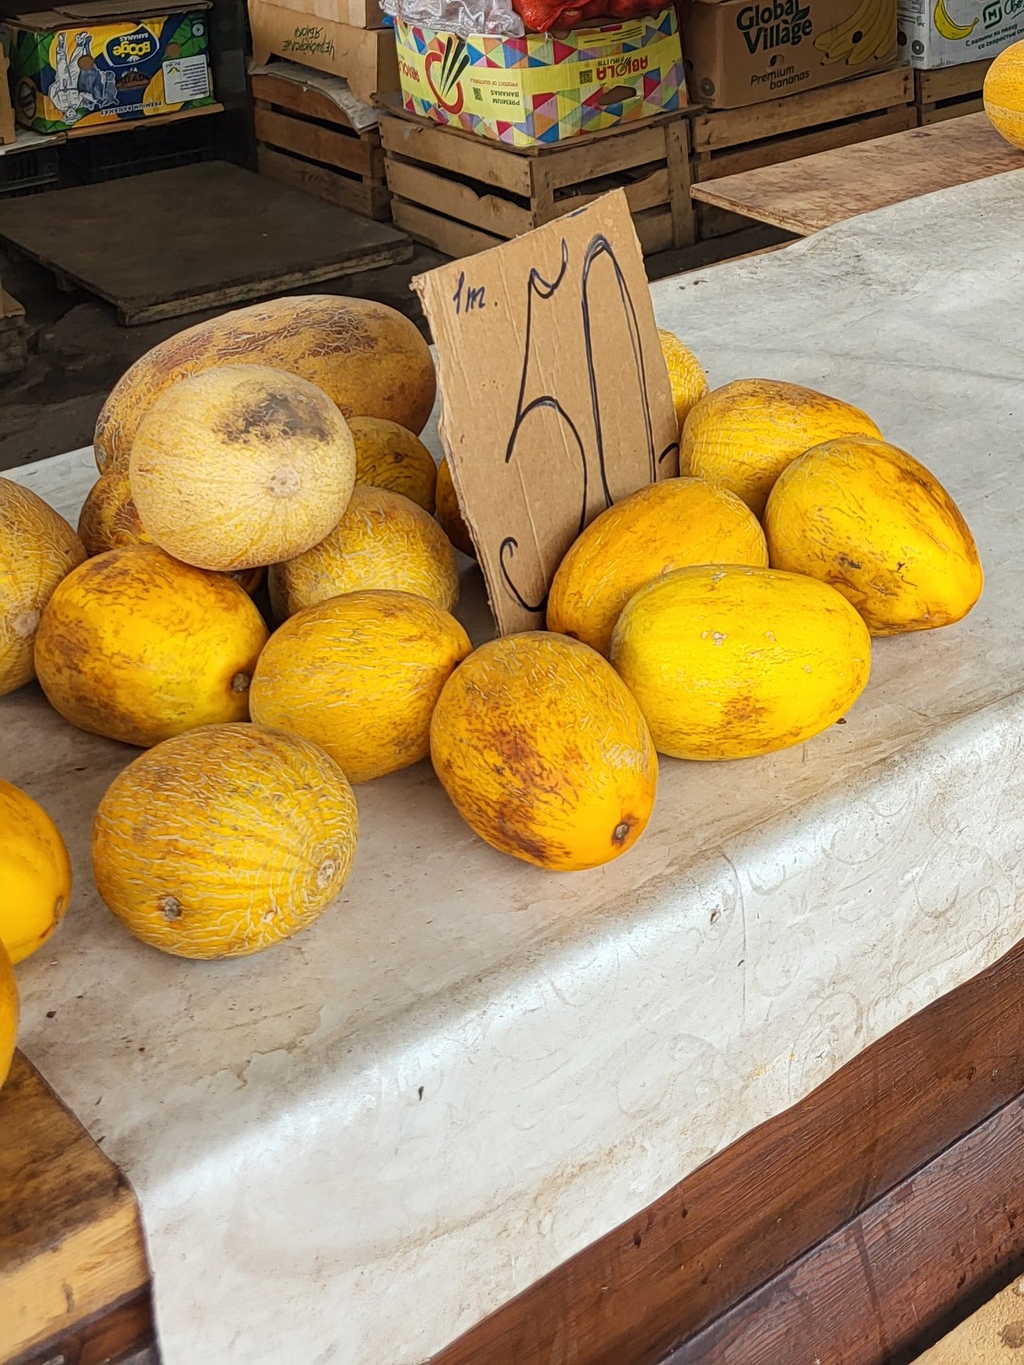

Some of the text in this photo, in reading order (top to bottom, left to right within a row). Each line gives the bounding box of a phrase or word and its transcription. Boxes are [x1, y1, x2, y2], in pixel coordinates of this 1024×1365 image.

[119, 33, 149, 42] BANANAS
[743, 18, 813, 55] Village
[750, 65, 795, 86] Premium
[770, 70, 810, 90] bananas
[491, 89, 519, 98] BANANAS
[132, 100, 162, 111] PREMIUM
[492, 98, 520, 106] PREMIUM
